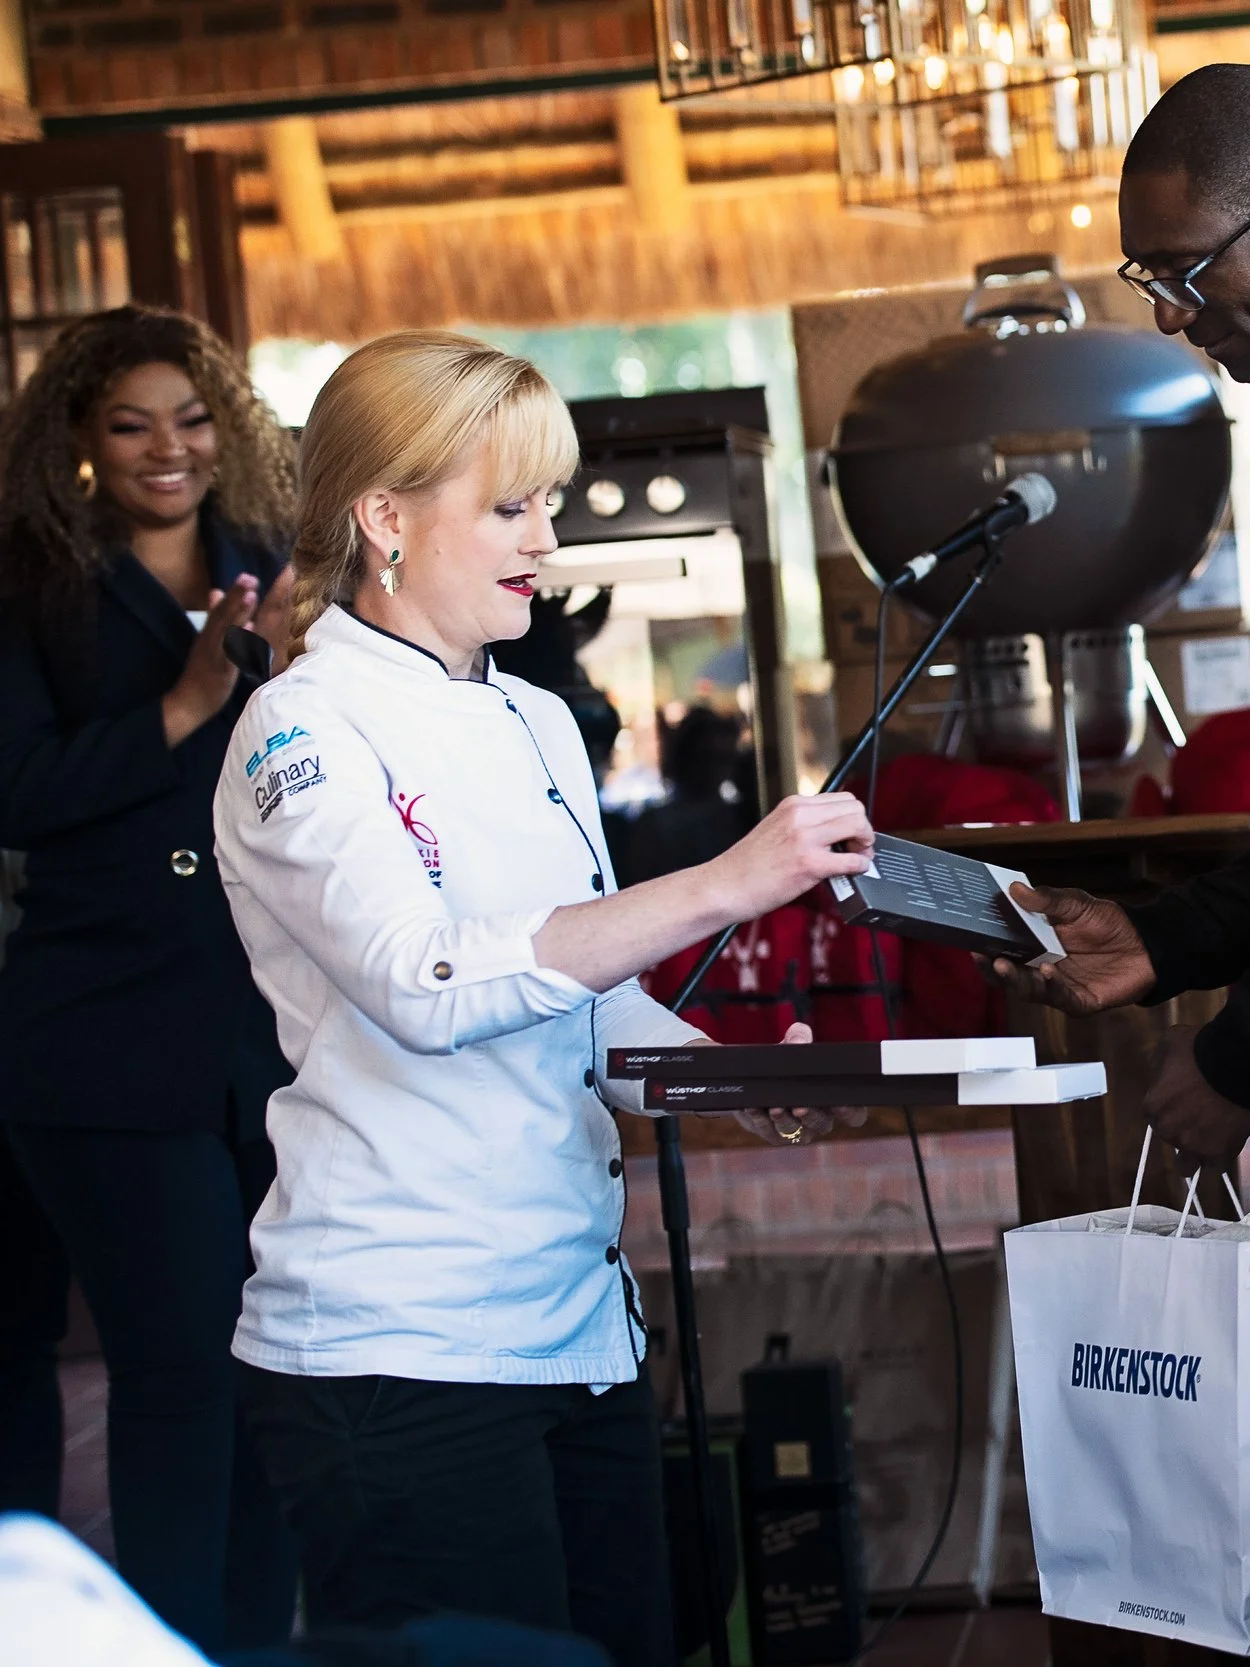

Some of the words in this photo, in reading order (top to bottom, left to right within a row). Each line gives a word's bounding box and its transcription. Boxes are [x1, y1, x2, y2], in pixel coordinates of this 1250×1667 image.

[255, 755, 320, 810] Culinary
[1071, 1342, 1202, 1402] BIRKENSTOCK
[1118, 1600, 1186, 1626] BIRKENSTOCK.COM
